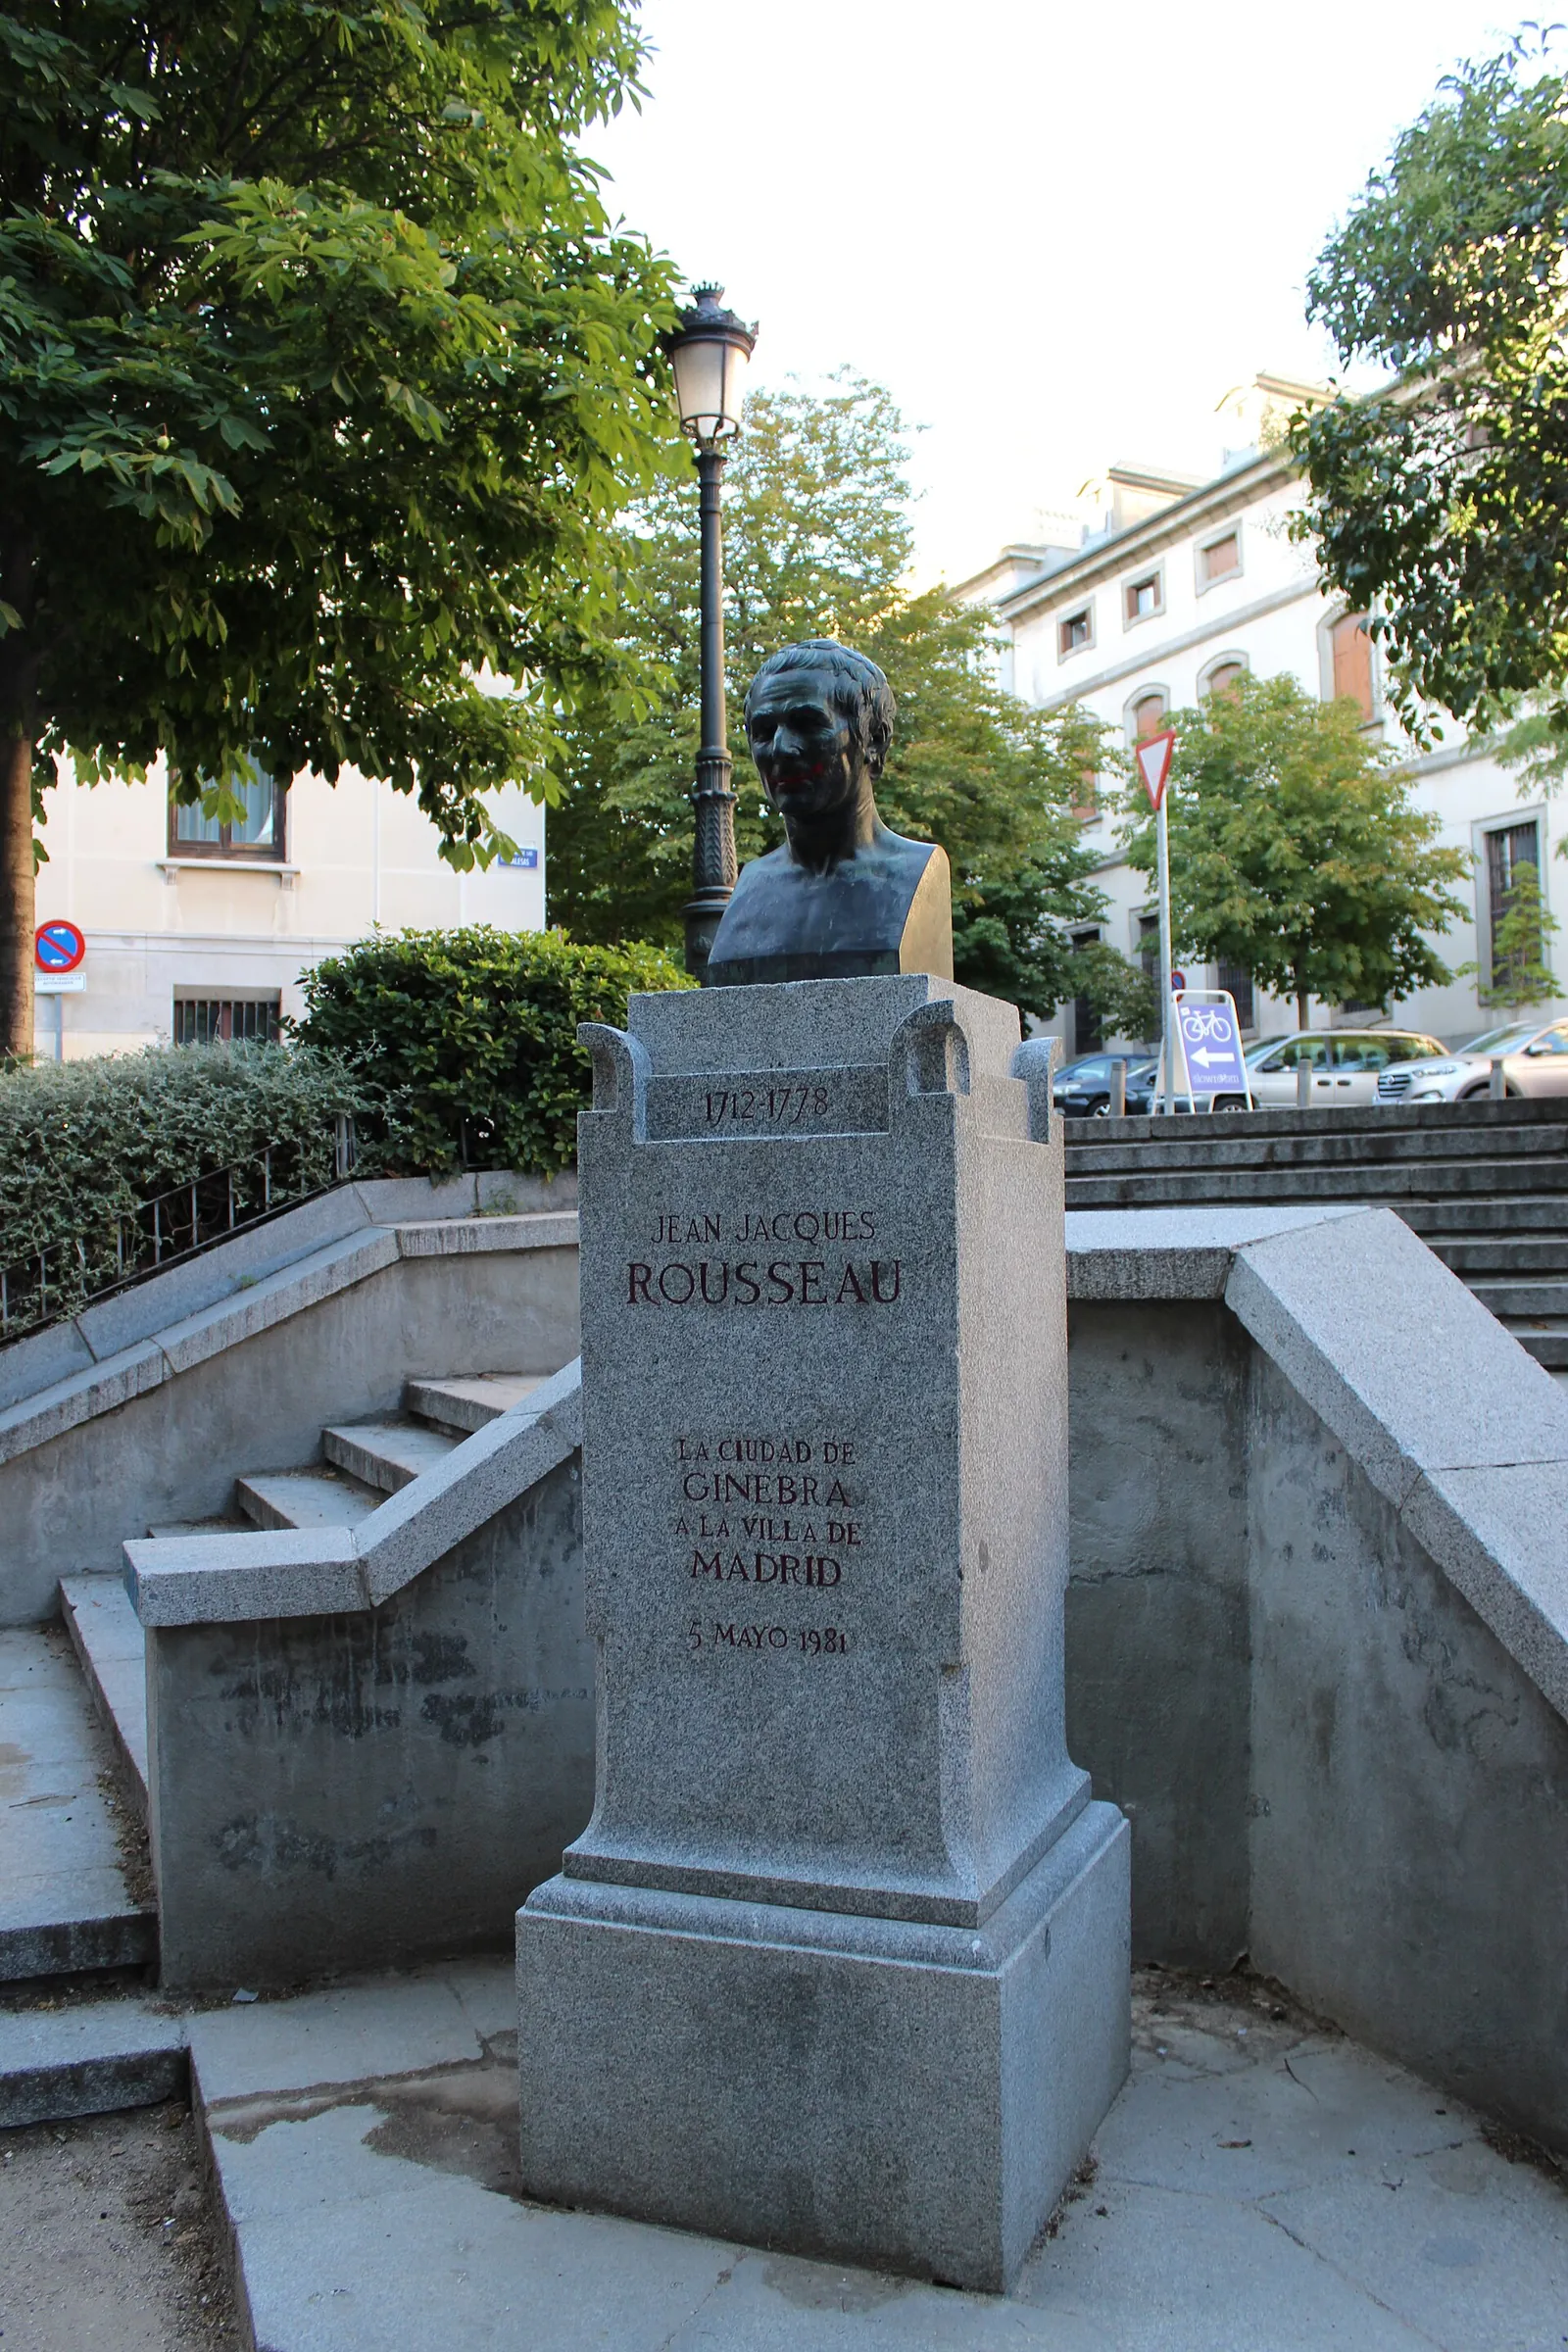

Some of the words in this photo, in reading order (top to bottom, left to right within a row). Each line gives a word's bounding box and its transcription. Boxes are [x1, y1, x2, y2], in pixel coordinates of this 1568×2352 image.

[706, 1087, 829, 1127] 1712-1778
[651, 1213, 722, 1244] JEAN
[736, 1211, 876, 1246] JACQUES
[626, 1259, 903, 1306] ROUSSEAU
[678, 1439, 710, 1461] LA
[718, 1439, 811, 1464] CIUDAD
[823, 1441, 857, 1465] DE
[683, 1472, 852, 1507] GINEBRA
[675, 1517, 689, 1535] A
[700, 1515, 730, 1538] LA
[741, 1516, 818, 1543] VILLA
[827, 1521, 862, 1545] DE
[690, 1549, 842, 1588] MADRID
[688, 1619, 702, 1650] 5
[714, 1623, 788, 1649] MAYO
[800, 1628, 847, 1656] 1981
